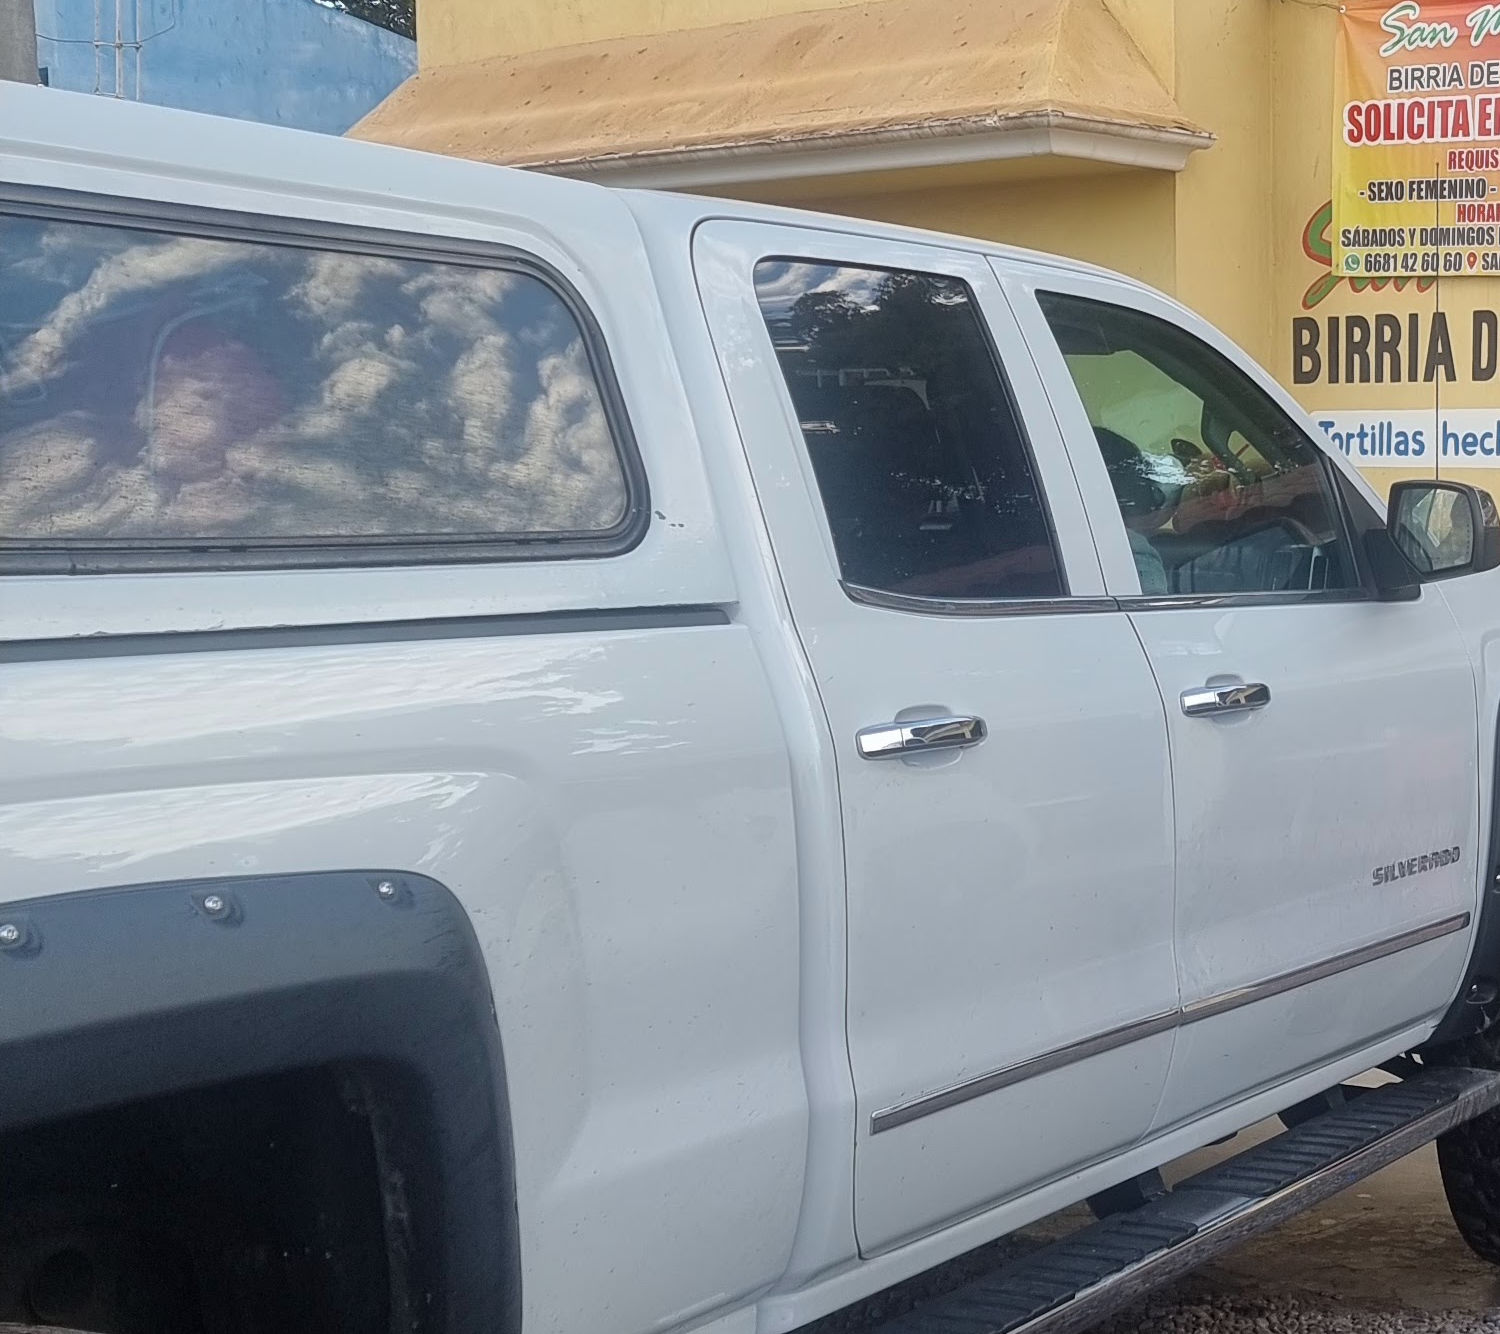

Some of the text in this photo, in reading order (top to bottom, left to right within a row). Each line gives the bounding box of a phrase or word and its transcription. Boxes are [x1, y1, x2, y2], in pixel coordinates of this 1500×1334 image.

[1380, 2, 1457, 55] San
[1388, 64, 1464, 91] BIRRIA
[1469, 62, 1500, 87] DE
[1346, 98, 1471, 144] SOLICITA
[1408, 177, 1487, 201] FEMENINO
[1340, 225, 1406, 248] SÁBADOS
[1408, 227, 1417, 248] Y
[1419, 226, 1496, 247] DOMINGOS
[1292, 311, 1458, 385] BIRRIA
[1371, 845, 1461, 887] SILVERADO
